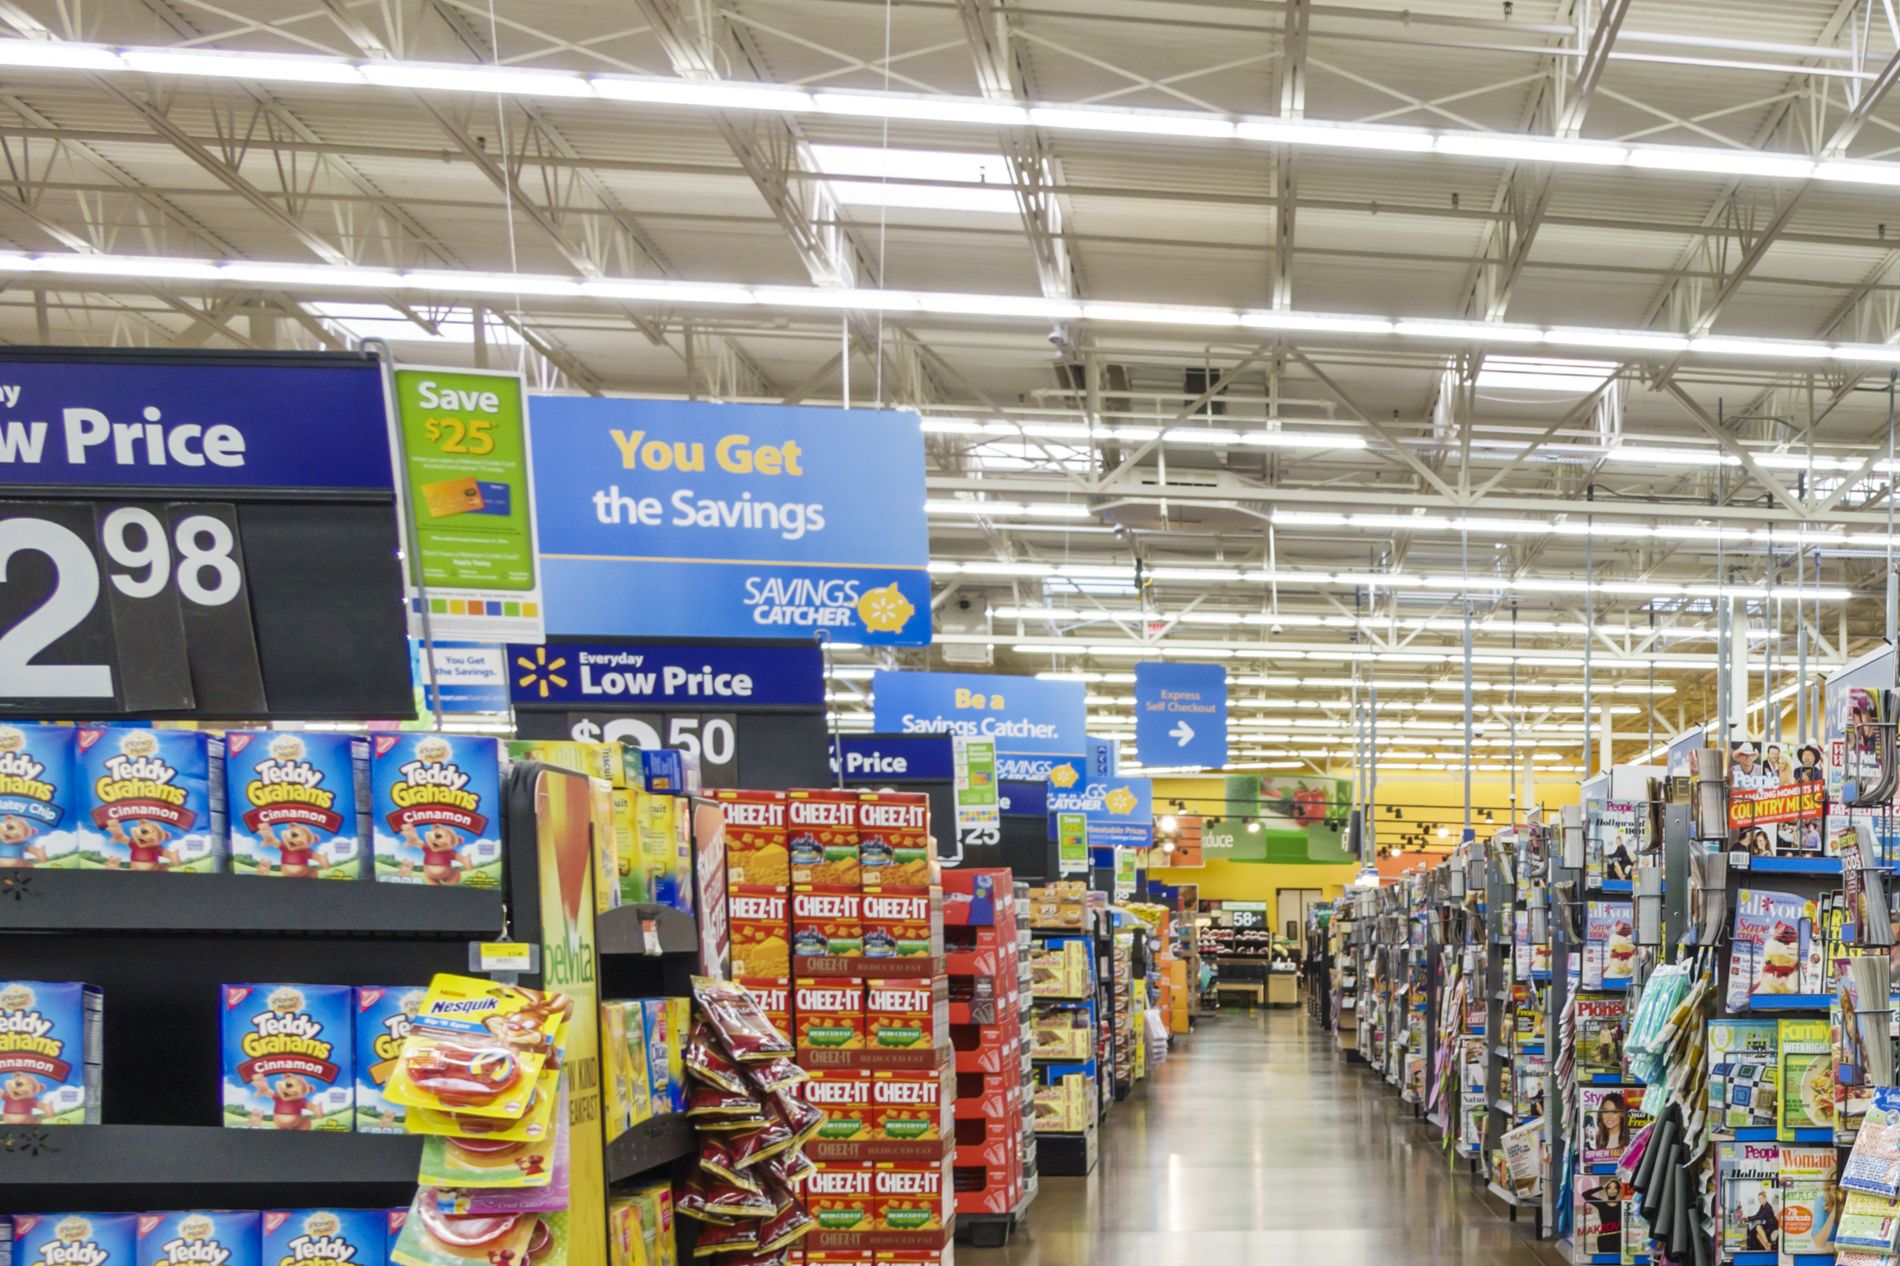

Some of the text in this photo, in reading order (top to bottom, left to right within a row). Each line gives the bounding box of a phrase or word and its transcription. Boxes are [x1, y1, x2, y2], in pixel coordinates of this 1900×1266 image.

[418, 381, 499, 413] Save
[62, 407, 245, 466] Price
[610, 429, 803, 476] You Get
[592, 485, 825, 539] the Savings
[744, 577, 860, 606] SAVINGS
[753, 606, 852, 625] CATCHER
[446, 656, 464, 664] You
[579, 653, 643, 667] Everyday
[581, 666, 752, 696] Low Price
[955, 689, 1004, 709] Be a
[1161, 690, 1201, 702] Express
[1146, 702, 1216, 713] Self Checkout
[902, 715, 977, 735] Savings
[106, 756, 176, 786] Teddy
[256, 759, 322, 787] Teddy
[847, 753, 907, 773] Price
[402, 762, 467, 790] Teddy
[1733, 770, 1779, 791] People
[96, 776, 186, 804] Grahams
[247, 780, 333, 808] Grahams
[390, 783, 478, 812] Grahams
[108, 804, 178, 822] Cinnamon
[259, 808, 327, 824] Cinnamon
[790, 801, 856, 825] CHEEZ-IT
[860, 804, 925, 827] CHEEZ-IT
[1731, 798, 1786, 819] COUNTRY
[1787, 793, 1822, 813] MUSIC
[402, 810, 471, 825] Cinnamon
[794, 895, 860, 917] CHEEZ-IT
[864, 898, 928, 918] CHEEZ-IT
[807, 959, 849, 972] CHEEZ-IT
[431, 999, 499, 1014] Nesquik
[797, 989, 861, 1012] CHEEZ-IT
[868, 990, 930, 1012] CHEEZ-IT
[252, 1012, 322, 1039] Teddy
[1782, 1020, 1830, 1039] Family
[242, 1032, 331, 1060] Grahams
[254, 1060, 323, 1075] Cinnamon
[289, 1237, 356, 1263] Teddy
